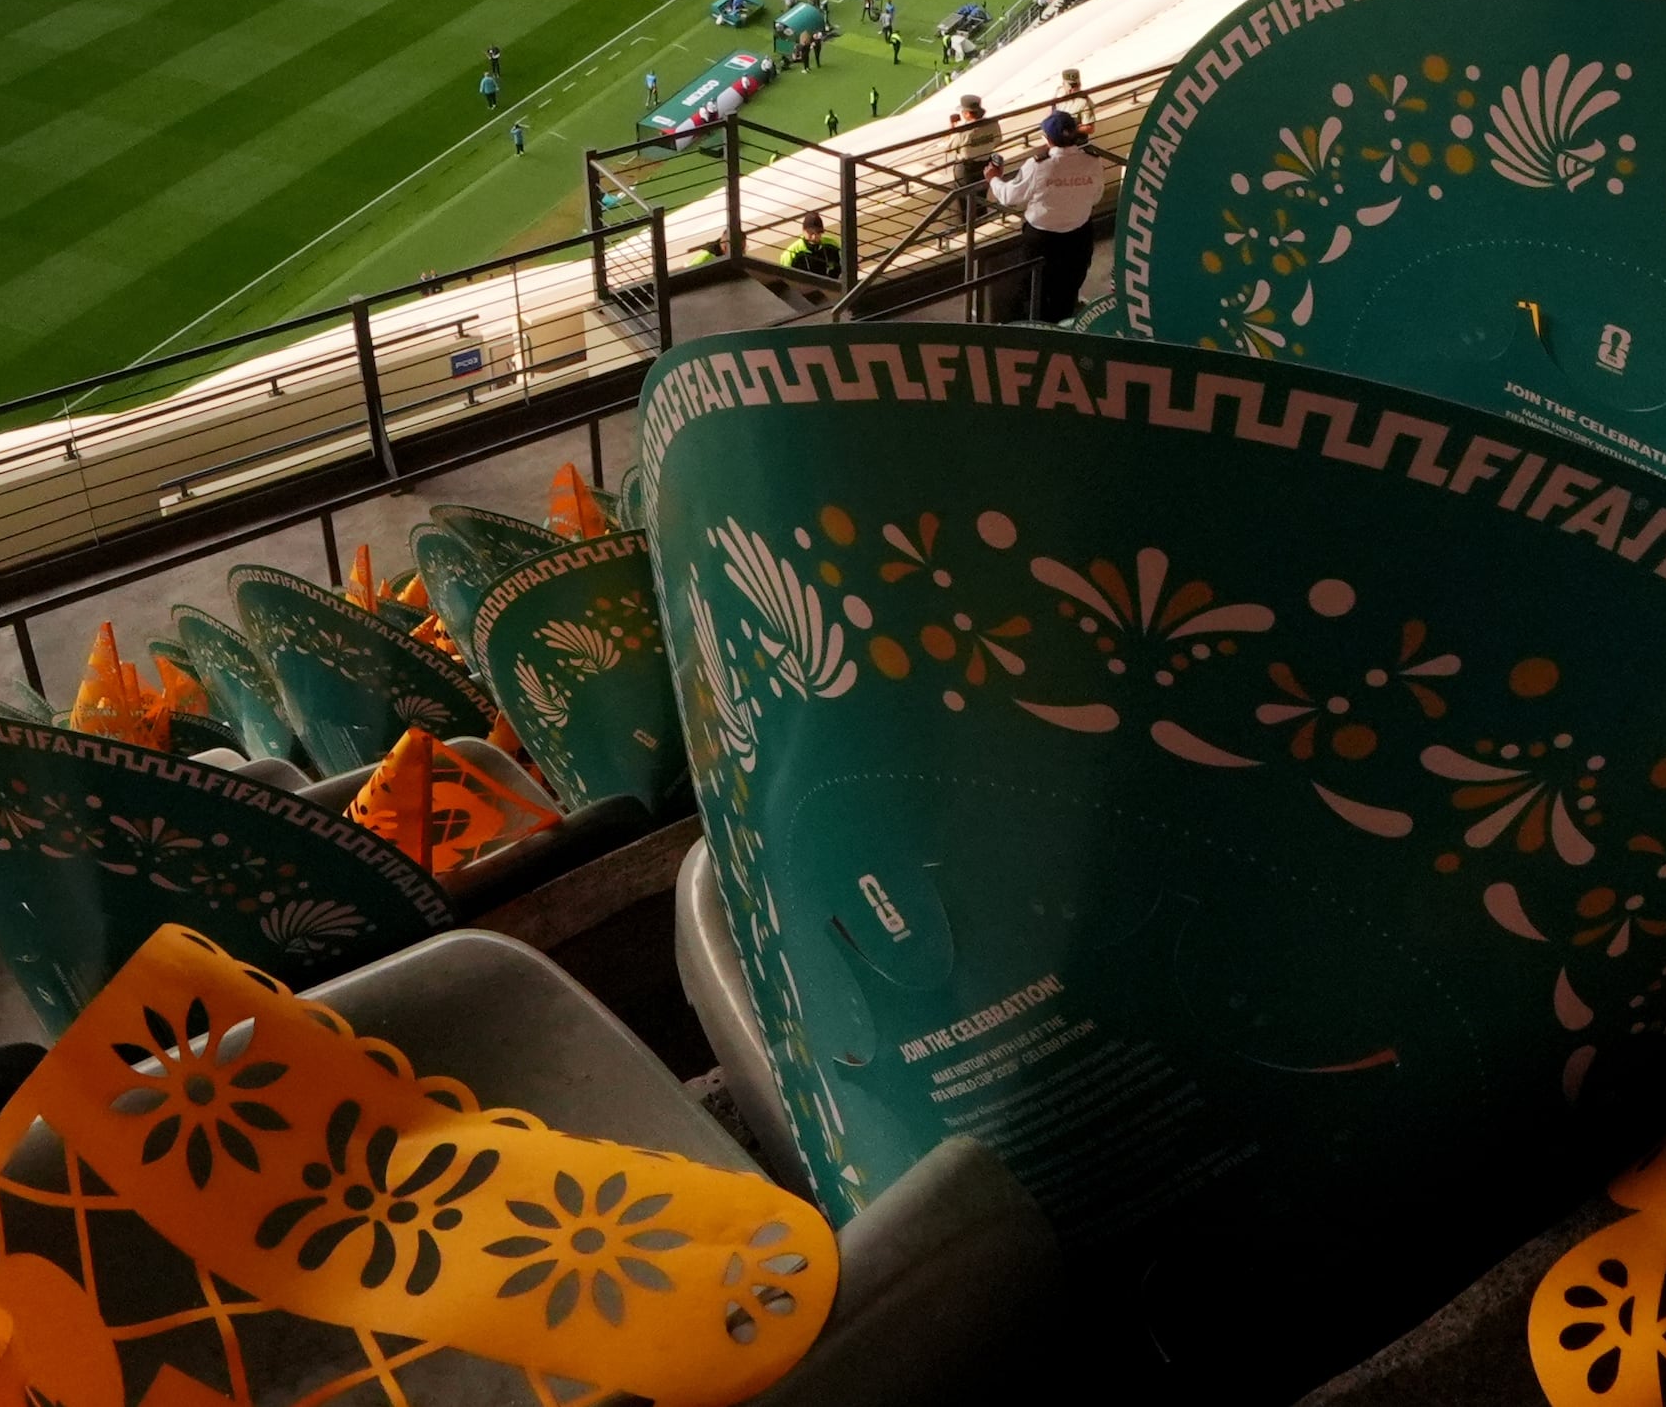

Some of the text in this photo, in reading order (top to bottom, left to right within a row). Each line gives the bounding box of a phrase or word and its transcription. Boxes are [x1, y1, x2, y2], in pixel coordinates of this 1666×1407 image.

[682, 79, 720, 106] MEXICO
[1133, 132, 1175, 203] FIFA
[662, 356, 725, 416] FIFA
[932, 343, 1105, 415] FIFA
[1504, 381, 1542, 406] JOIN
[1544, 397, 1576, 422] THE
[1522, 407, 1550, 426] MAKE
[1550, 420, 1593, 446] HISTORY
[1444, 434, 1636, 544] FIFA
[508, 570, 539, 600] FIFA
[364, 615, 401, 641] FIFA
[10, 726, 75, 757] FIFA
[205, 771, 270, 814] FIFA
[375, 851, 426, 892] FIFA
[899, 973, 1066, 1064] JOIN THE CELEBRATION!
[955, 1054, 990, 1076] HISTORY
[1041, 1014, 1068, 1034] THE
[947, 1077, 976, 1098] WORLD
